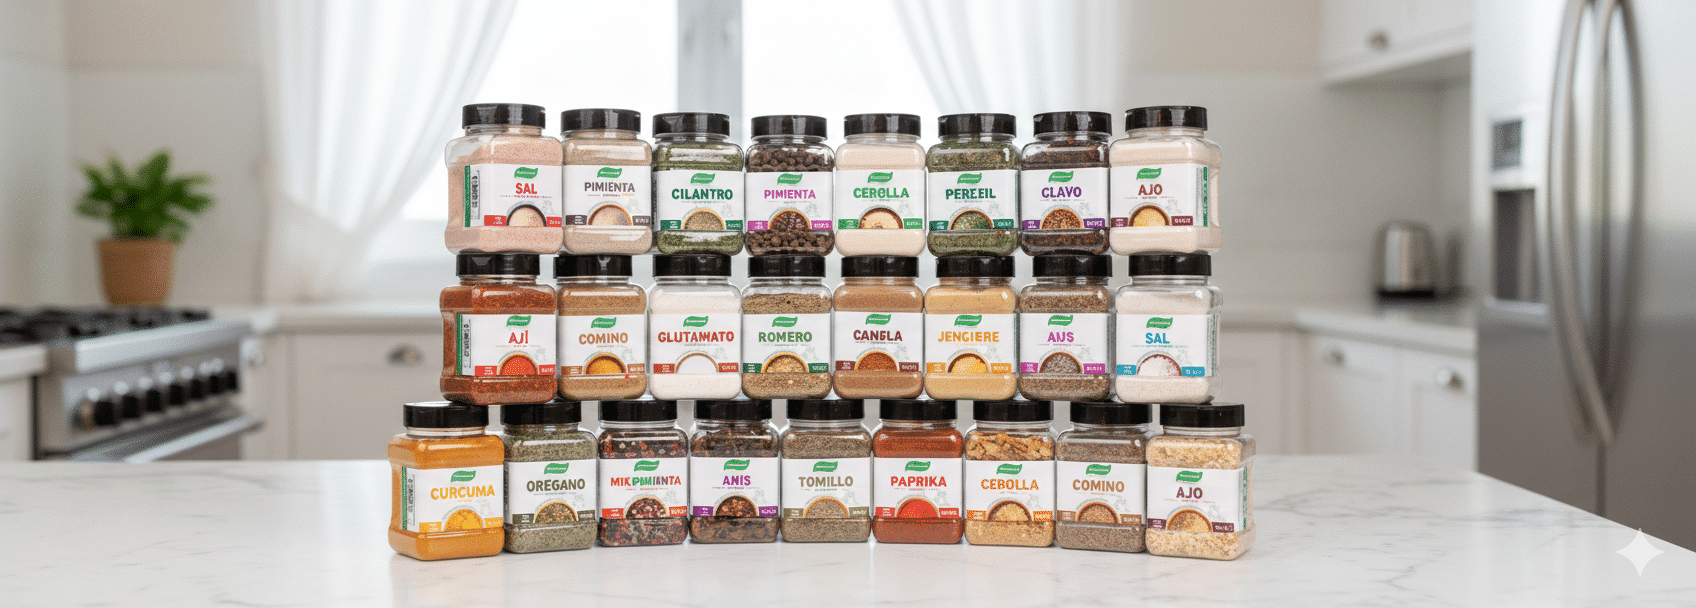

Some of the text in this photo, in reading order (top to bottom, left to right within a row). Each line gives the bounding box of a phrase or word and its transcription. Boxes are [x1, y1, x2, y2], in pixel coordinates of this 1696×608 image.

[515, 183, 538, 195] SAL
[584, 182, 635, 193] PIMIENTA
[1041, 186, 1082, 199] CLAVO
[1138, 184, 1163, 196] AJO
[671, 189, 733, 200] CILANTRO
[764, 189, 816, 200] PIMIENTA
[578, 332, 628, 345] COMINO
[658, 331, 735, 343] GLUTAMATO
[758, 331, 812, 343] ROMERO
[1145, 332, 1170, 345] SAL
[526, 478, 586, 492] OREGANO
[798, 475, 854, 488] TOMILLO
[890, 475, 947, 488] PAPRIKA
[981, 478, 1040, 491] CEBOLLA
[1072, 478, 1125, 493] COMINO
[430, 485, 495, 500] CURCUMA
[1176, 486, 1204, 499] AJO
